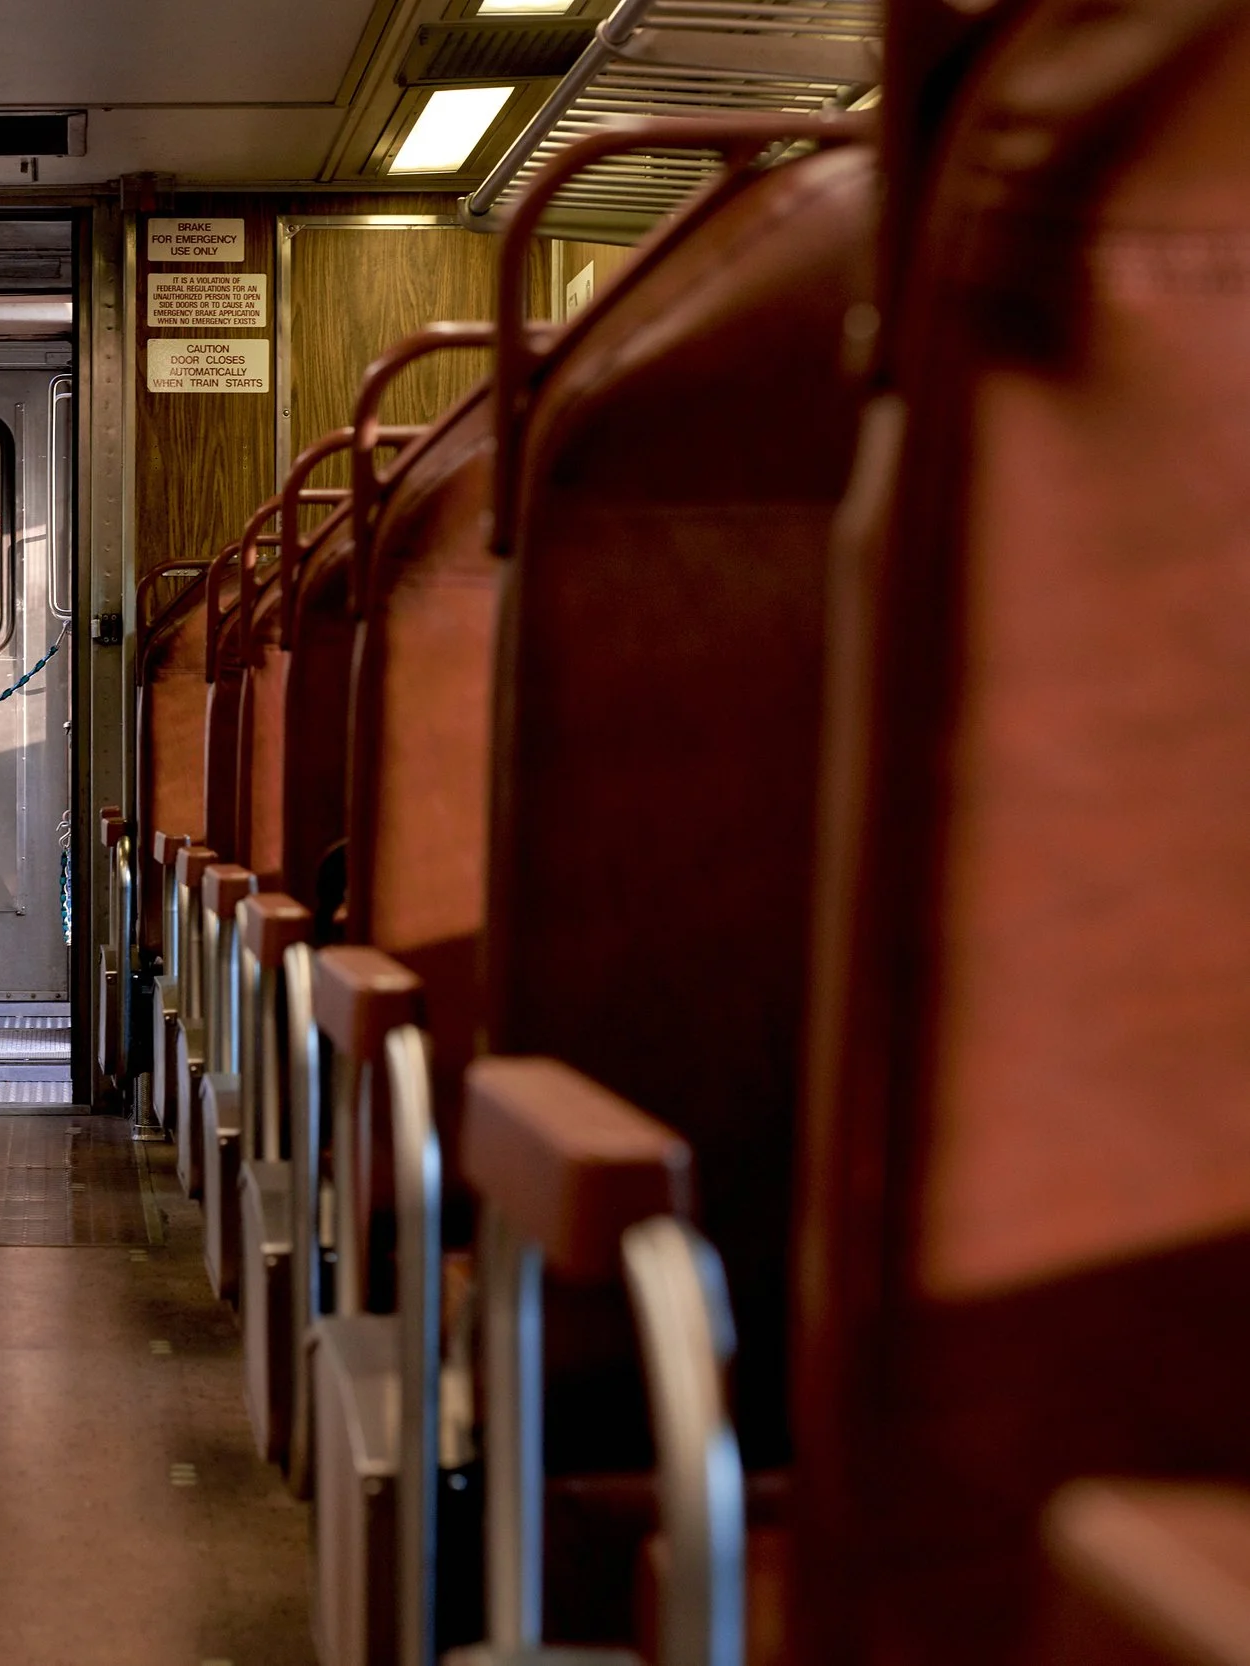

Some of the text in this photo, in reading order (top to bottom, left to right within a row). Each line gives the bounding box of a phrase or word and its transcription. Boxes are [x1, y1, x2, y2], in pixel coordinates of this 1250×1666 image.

[178, 223, 211, 232] BRAKE
[152, 235, 237, 244] FOR EMERGENCY
[170, 247, 218, 256] USE ONLY
[186, 344, 230, 354] CAUTION
[170, 356, 246, 365] DOOR CLOSES
[169, 367, 247, 376] AUTOMATICALLY
[153, 379, 263, 388] WHEN TRAIN STARTS
